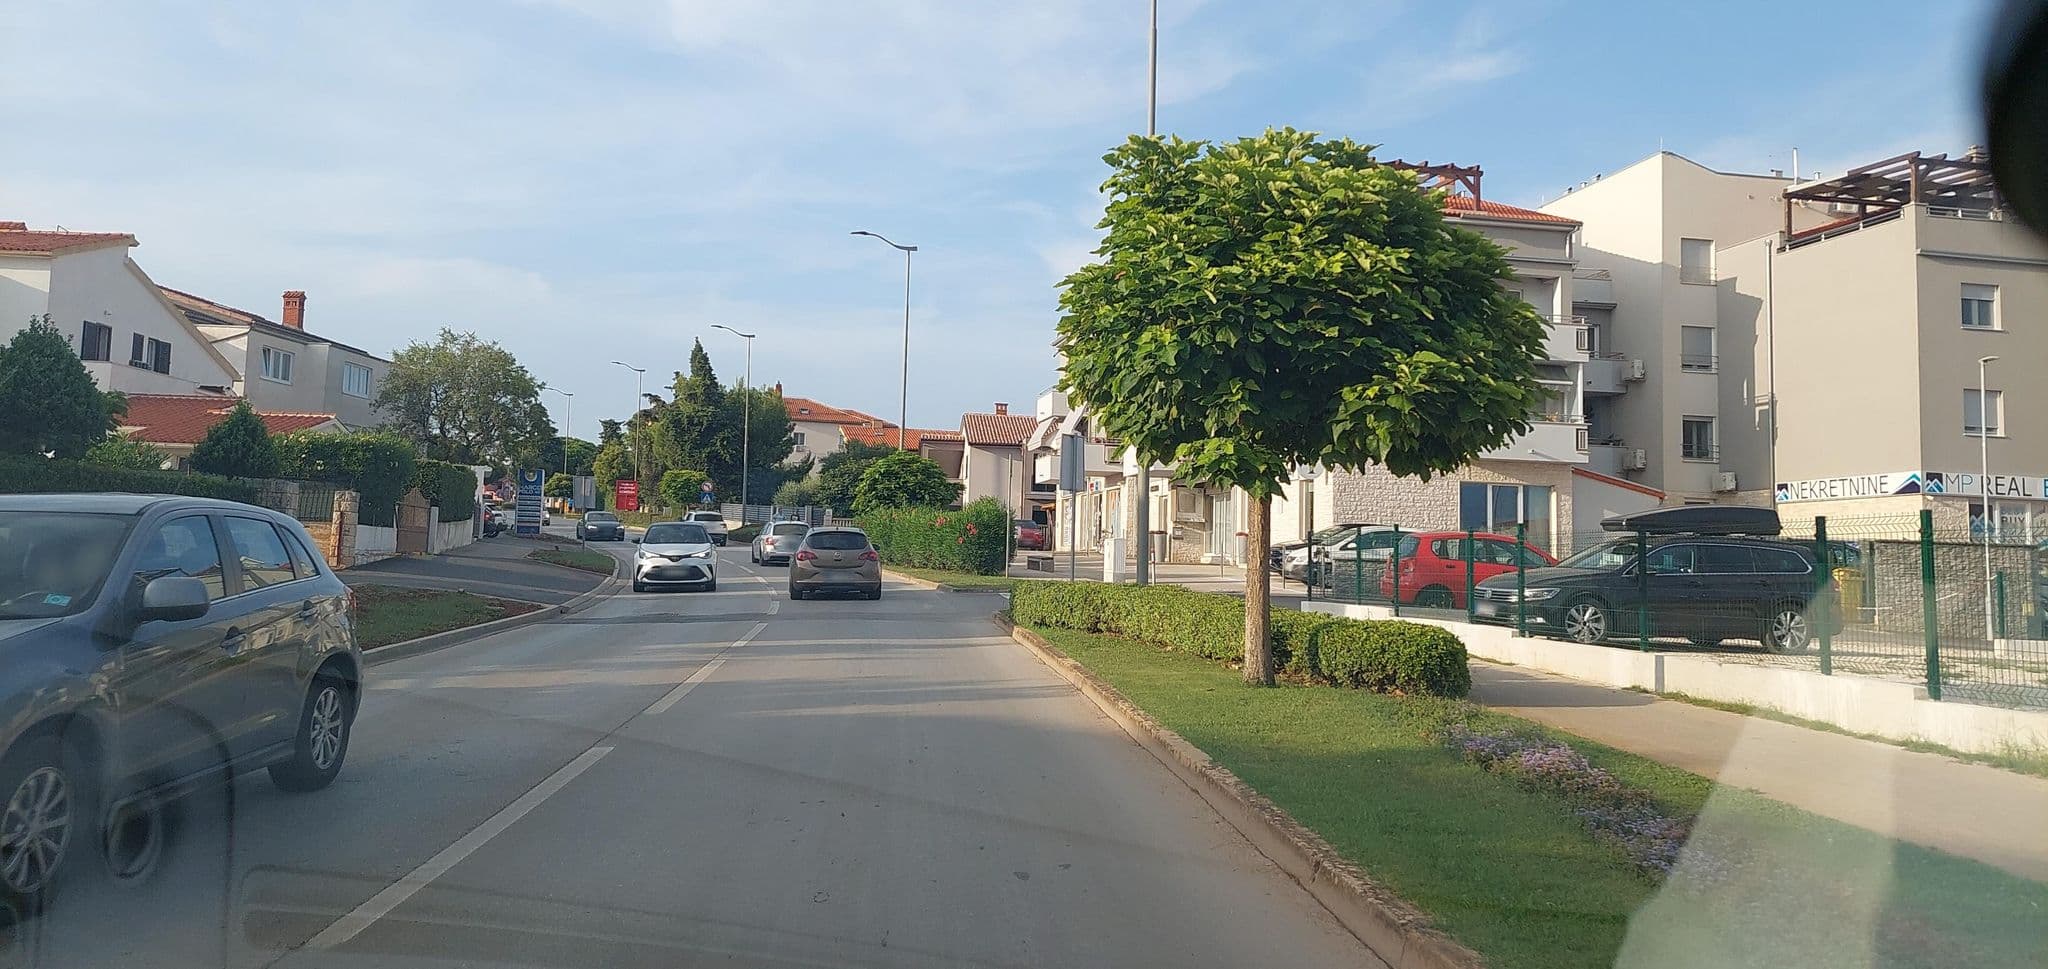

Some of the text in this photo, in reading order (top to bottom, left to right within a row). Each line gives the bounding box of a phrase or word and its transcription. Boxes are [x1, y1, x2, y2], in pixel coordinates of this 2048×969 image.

[1790, 475, 1888, 499] NEKRETNINE
[1945, 474, 1973, 493] MP
[1980, 475, 2032, 497] REAL
